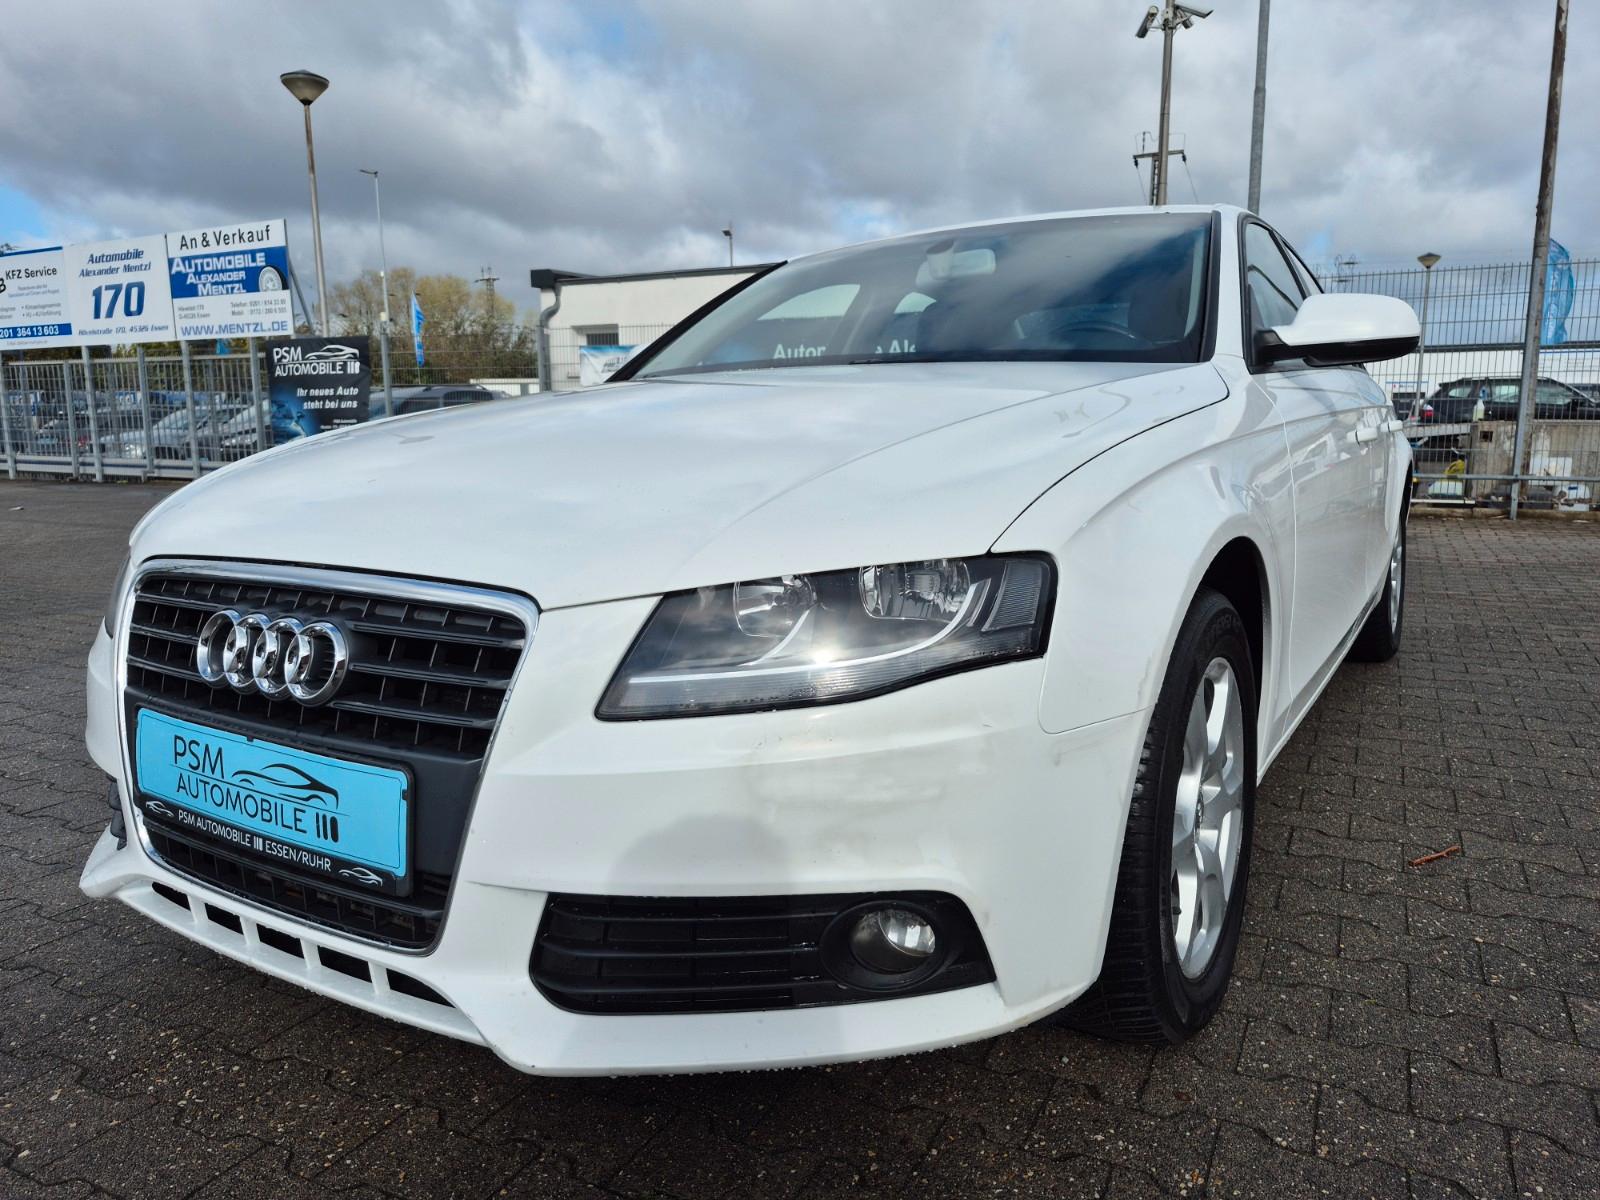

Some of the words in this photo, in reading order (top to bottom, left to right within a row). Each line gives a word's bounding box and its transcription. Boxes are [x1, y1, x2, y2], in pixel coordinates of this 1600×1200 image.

[180, 234, 198, 250] An
[201, 231, 210, 248] &
[213, 224, 271, 246] Verkauf
[87, 248, 144, 264] Automobile
[5, 269, 22, 280] KFZ
[24, 266, 57, 278] Service
[79, 266, 120, 277] Alexander
[123, 261, 151, 273] Mentzl
[92, 280, 145, 319] 170
[181, 320, 289, 337] WWW.MENTZL.DE
[273, 346, 302, 363] PSM
[275, 362, 344, 377] AUTOMOBILE
[296, 387, 308, 397] Ihr
[309, 387, 335, 396] neues
[336, 386, 359, 396] Auto
[303, 399, 323, 409] steht
[324, 399, 339, 409] bei
[340, 400, 358, 409] uns
[173, 734, 225, 780] PSM
[176, 773, 308, 835] AUTOMOBILE
[178, 809, 196, 826] PSM
[196, 818, 251, 847] AUTOMOBILE
[265, 841, 332, 871] ESSEN/RUHR
